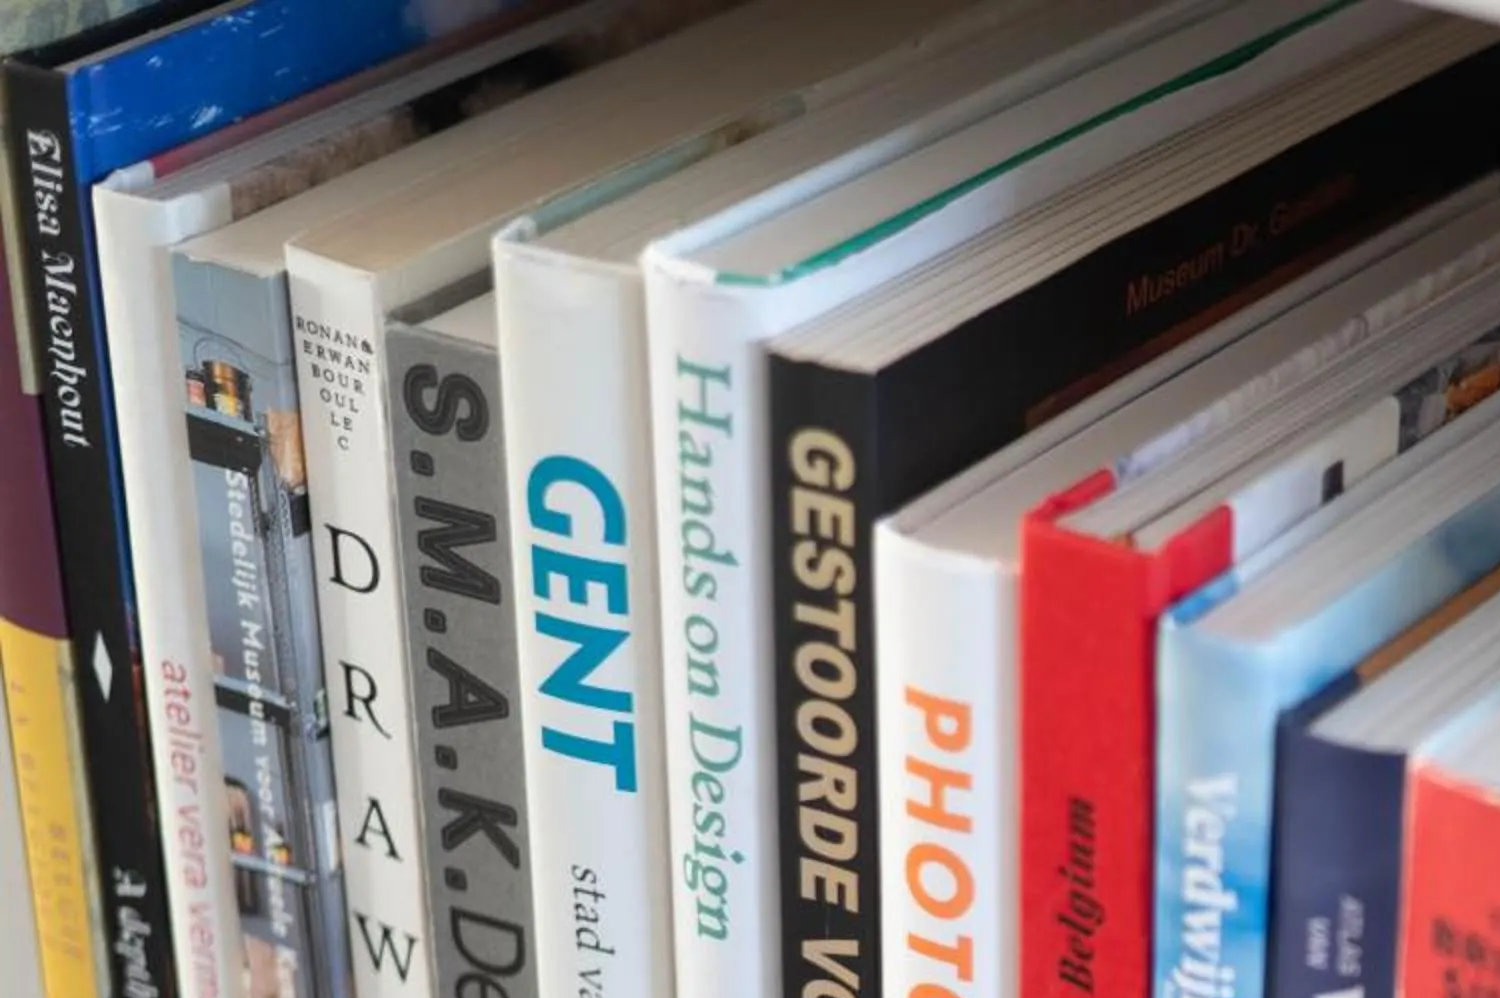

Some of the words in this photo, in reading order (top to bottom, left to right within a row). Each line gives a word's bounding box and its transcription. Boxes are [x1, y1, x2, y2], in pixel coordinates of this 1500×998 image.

[27, 130, 63, 237] Elisa
[1124, 242, 1225, 318] Museum
[42, 251, 92, 448] Maenhout
[303, 339, 371, 375] ERWAN
[311, 363, 365, 393] BOUR
[319, 387, 359, 413] OUL
[330, 411, 353, 432] LE
[336, 436, 350, 451] C
[676, 353, 741, 605] Hands
[225, 466, 261, 614] Stedelijk
[526, 454, 638, 793] GENT
[683, 614, 722, 702] on
[787, 426, 860, 915] GESTOORDE
[160, 661, 204, 791] atelier
[240, 619, 269, 747] Museum
[254, 754, 276, 819] voor
[685, 718, 744, 943] Design
[176, 817, 208, 889] vera
[1056, 793, 1106, 995] Belgium
[572, 864, 616, 956] stad
